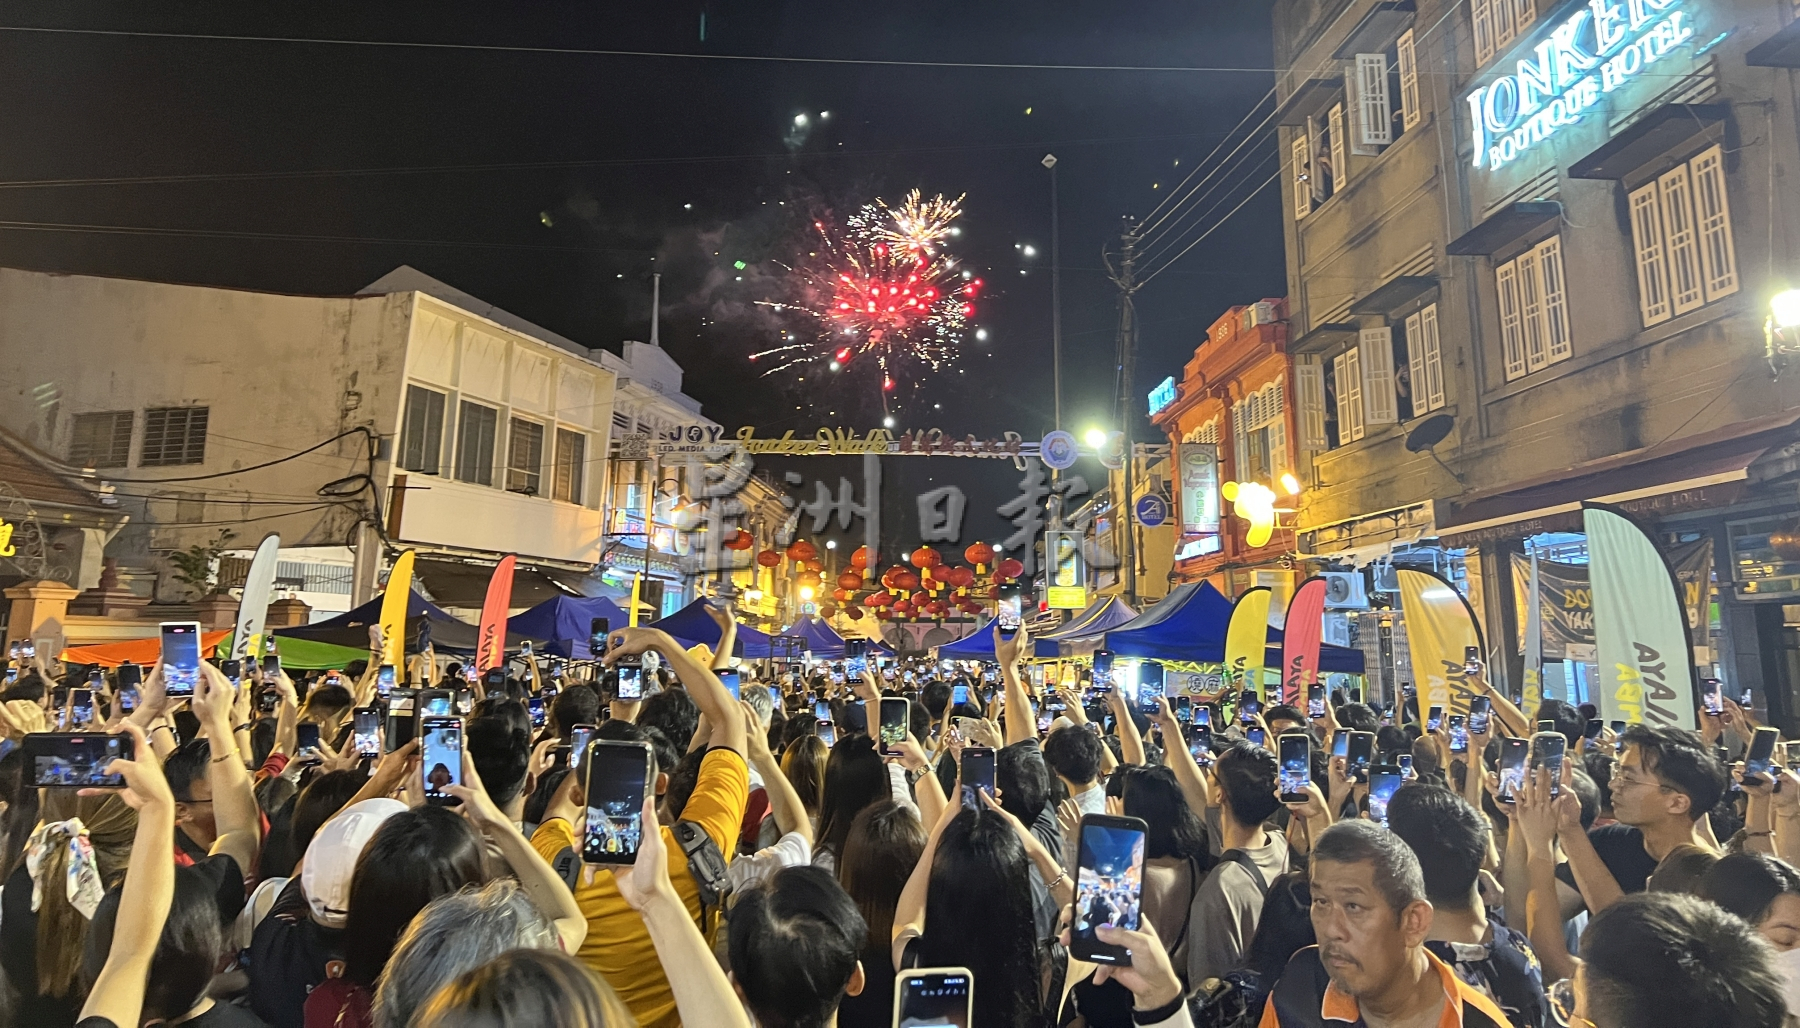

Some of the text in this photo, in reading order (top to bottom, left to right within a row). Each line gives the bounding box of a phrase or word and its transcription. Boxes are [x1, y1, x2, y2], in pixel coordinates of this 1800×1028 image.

[1488, 11, 1692, 171] BOUTIQUE HOTEL
[669, 425, 721, 444] JOY
[678, 445, 705, 453] MEDIA
